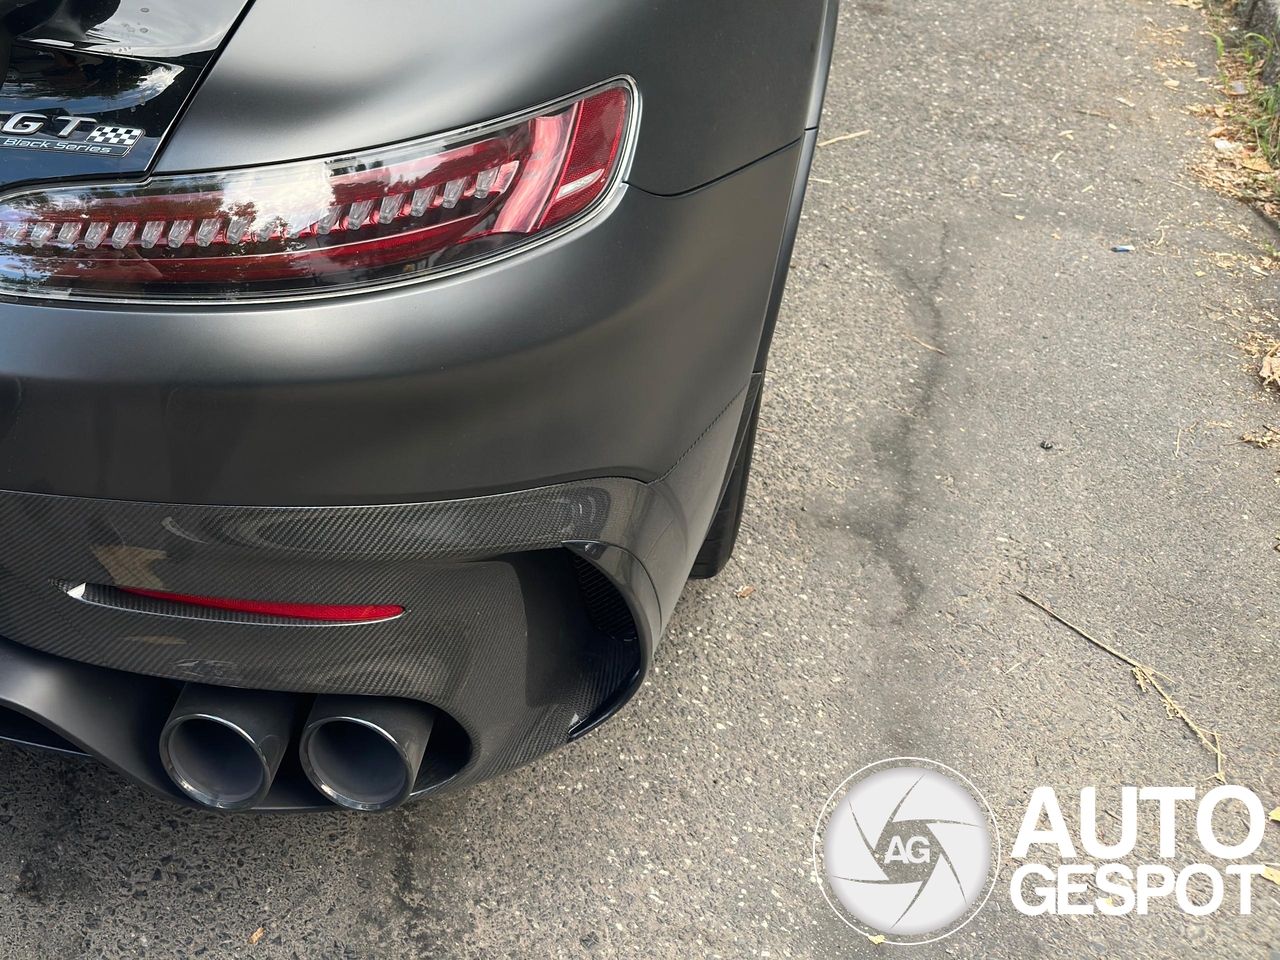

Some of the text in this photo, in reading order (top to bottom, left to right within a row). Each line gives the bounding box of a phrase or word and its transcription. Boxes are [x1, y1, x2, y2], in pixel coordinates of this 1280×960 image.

[0, 112, 99, 139] GT
[2, 138, 112, 154] Black Series
